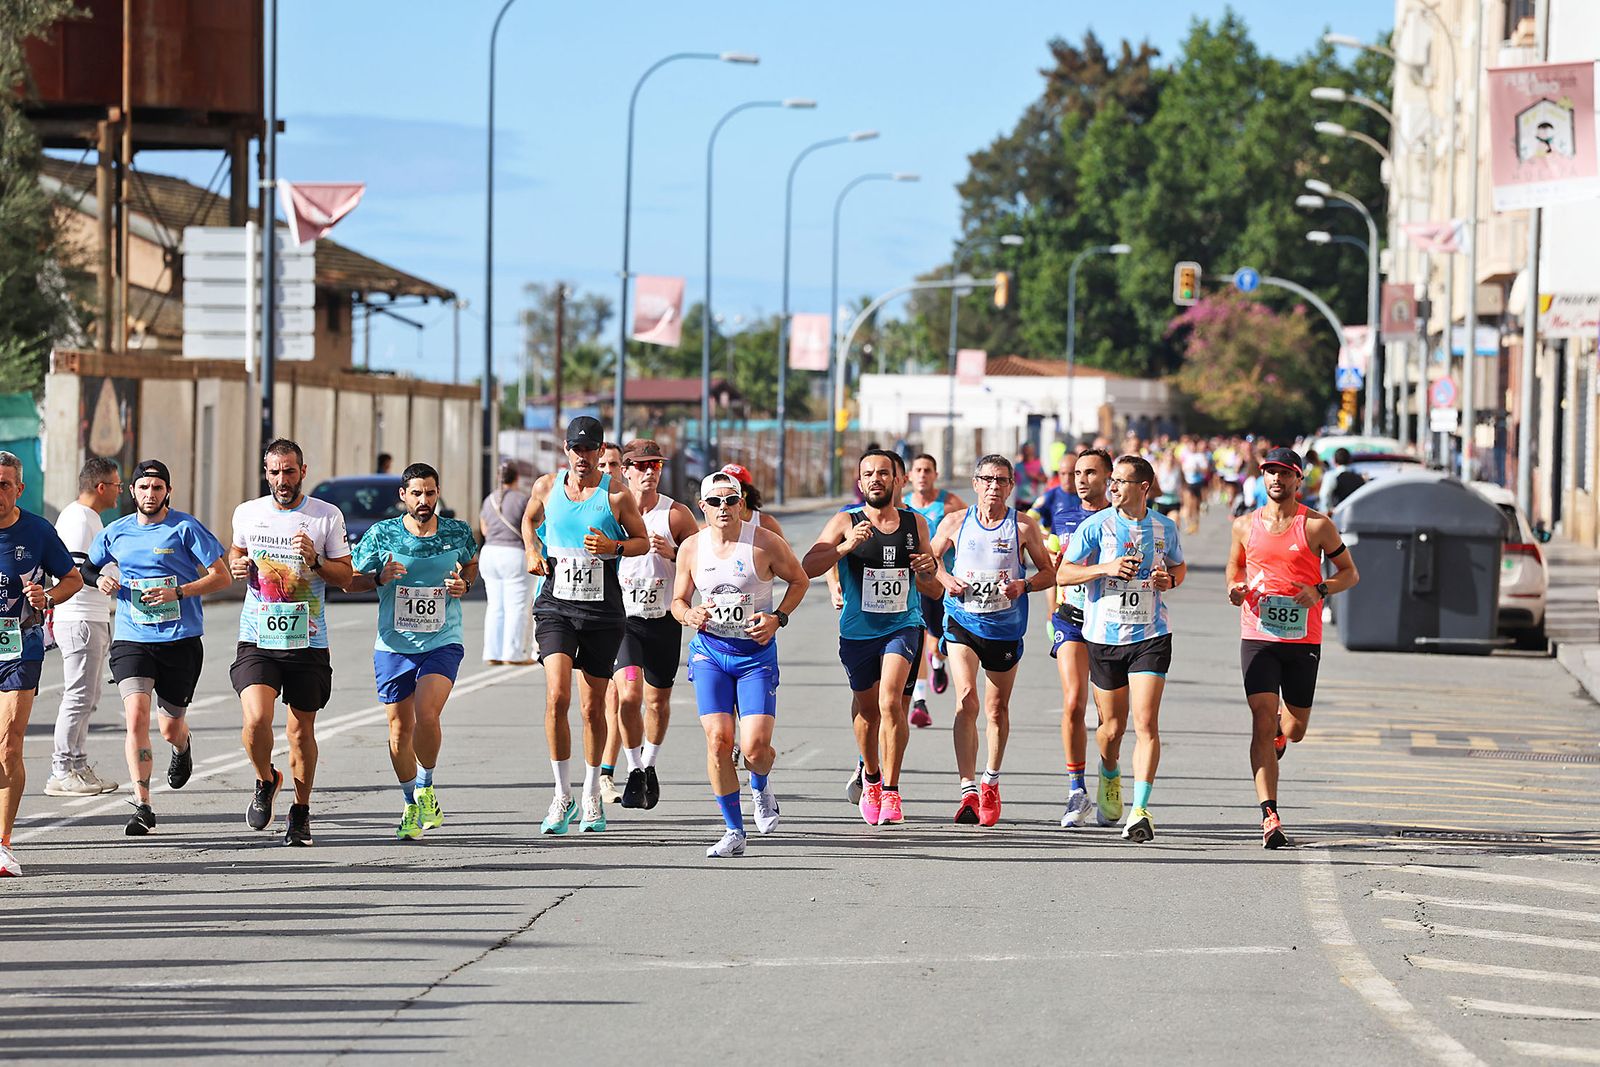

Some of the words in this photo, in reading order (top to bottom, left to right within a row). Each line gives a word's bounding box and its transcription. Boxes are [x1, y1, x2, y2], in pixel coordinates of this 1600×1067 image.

[564, 568, 592, 584] 141
[866, 569, 876, 578] 2K
[897, 569, 907, 578] 2K
[872, 581, 902, 596] 130
[1108, 579, 1118, 588] 2K
[1141, 581, 1151, 589] 2K
[399, 587, 410, 596] 2K
[433, 588, 443, 597] 2K
[629, 589, 657, 604] 125
[1119, 592, 1139, 607] 10
[295, 603, 306, 612] 2K
[405, 599, 436, 615] 168
[714, 606, 744, 622] 110
[1267, 607, 1299, 622] 585
[267, 615, 300, 632] 667
